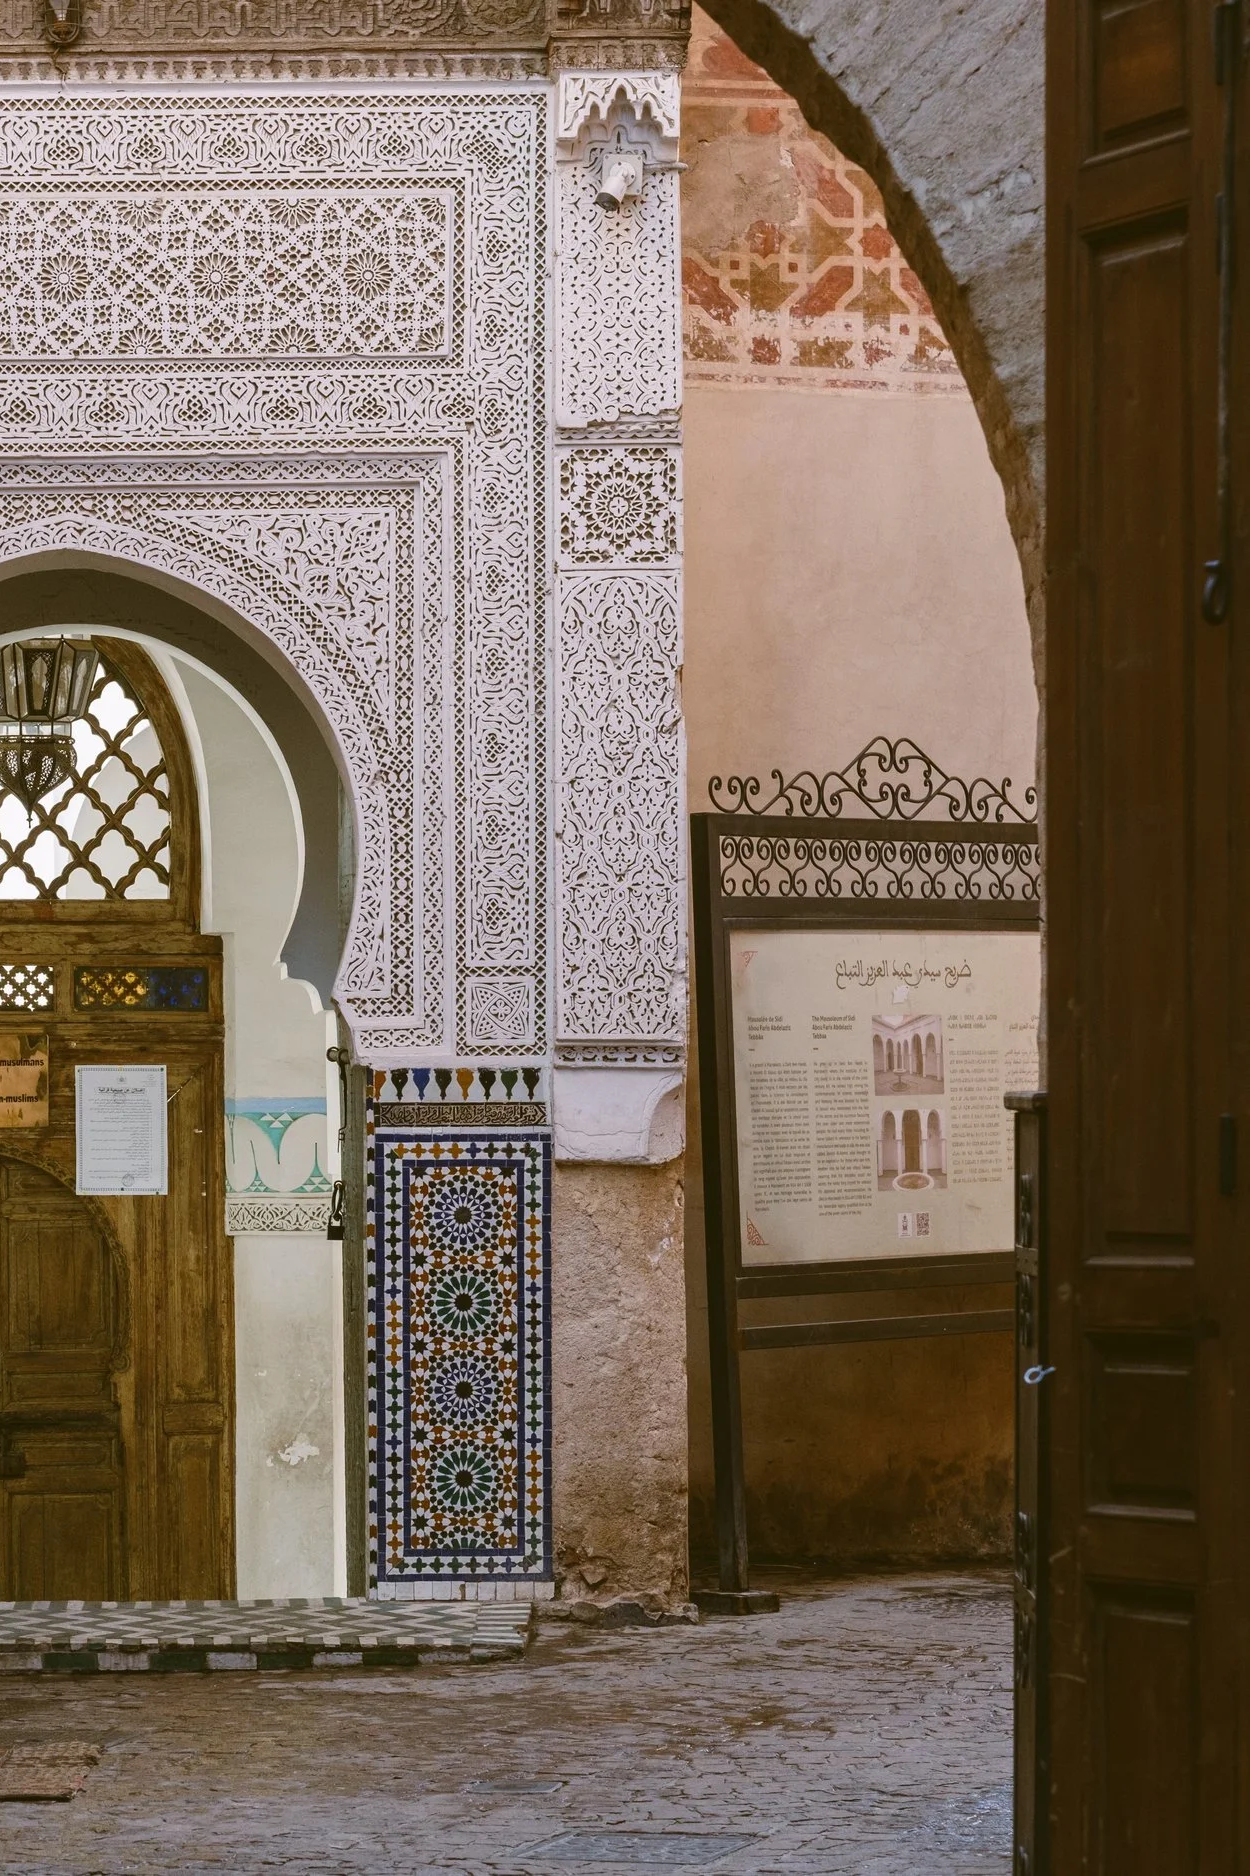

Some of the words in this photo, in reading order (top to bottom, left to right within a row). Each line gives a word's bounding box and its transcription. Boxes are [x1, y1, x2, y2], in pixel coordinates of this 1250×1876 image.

[835, 960, 864, 990] التباع
[859, 960, 889, 987] العزيز
[892, 960, 913, 980] عبد
[904, 960, 942, 989] سيدي
[944, 958, 972, 988] ضريح
